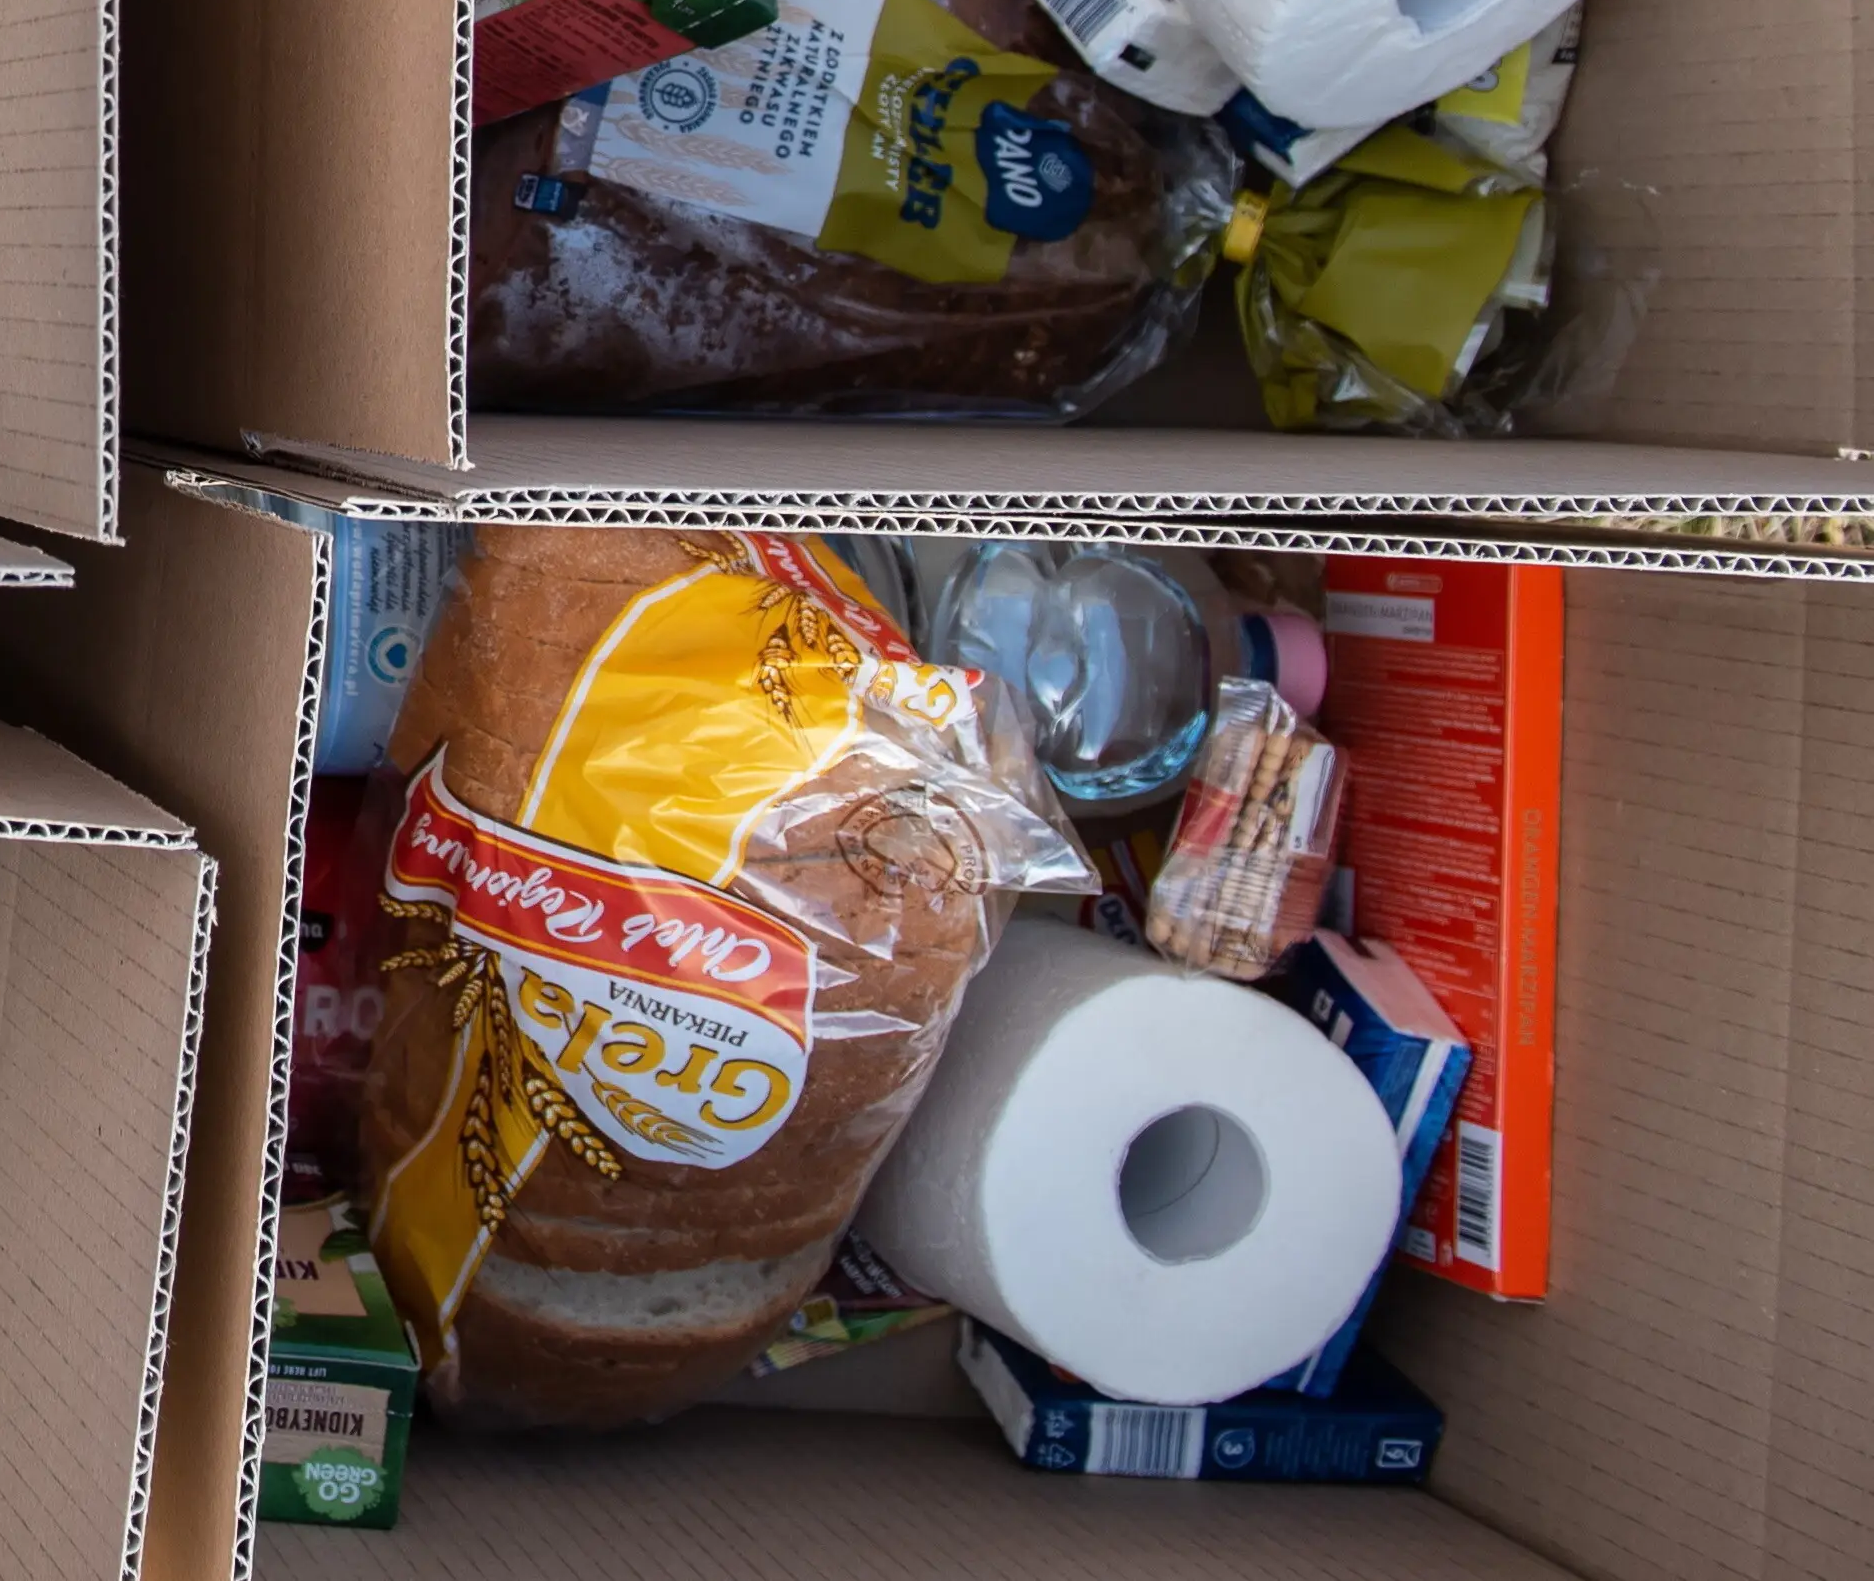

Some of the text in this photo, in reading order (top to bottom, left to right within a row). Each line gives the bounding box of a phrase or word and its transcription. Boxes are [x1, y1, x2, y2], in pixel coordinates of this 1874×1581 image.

[760, 35, 801, 129] ZAKWASU
[775, 20, 826, 160] NATURALNEGO
[620, 910, 773, 985] Chleb
[517, 966, 793, 1132] Grela
[607, 980, 750, 1048] PIEKARNIA
[318, 1480, 361, 1504] GO
